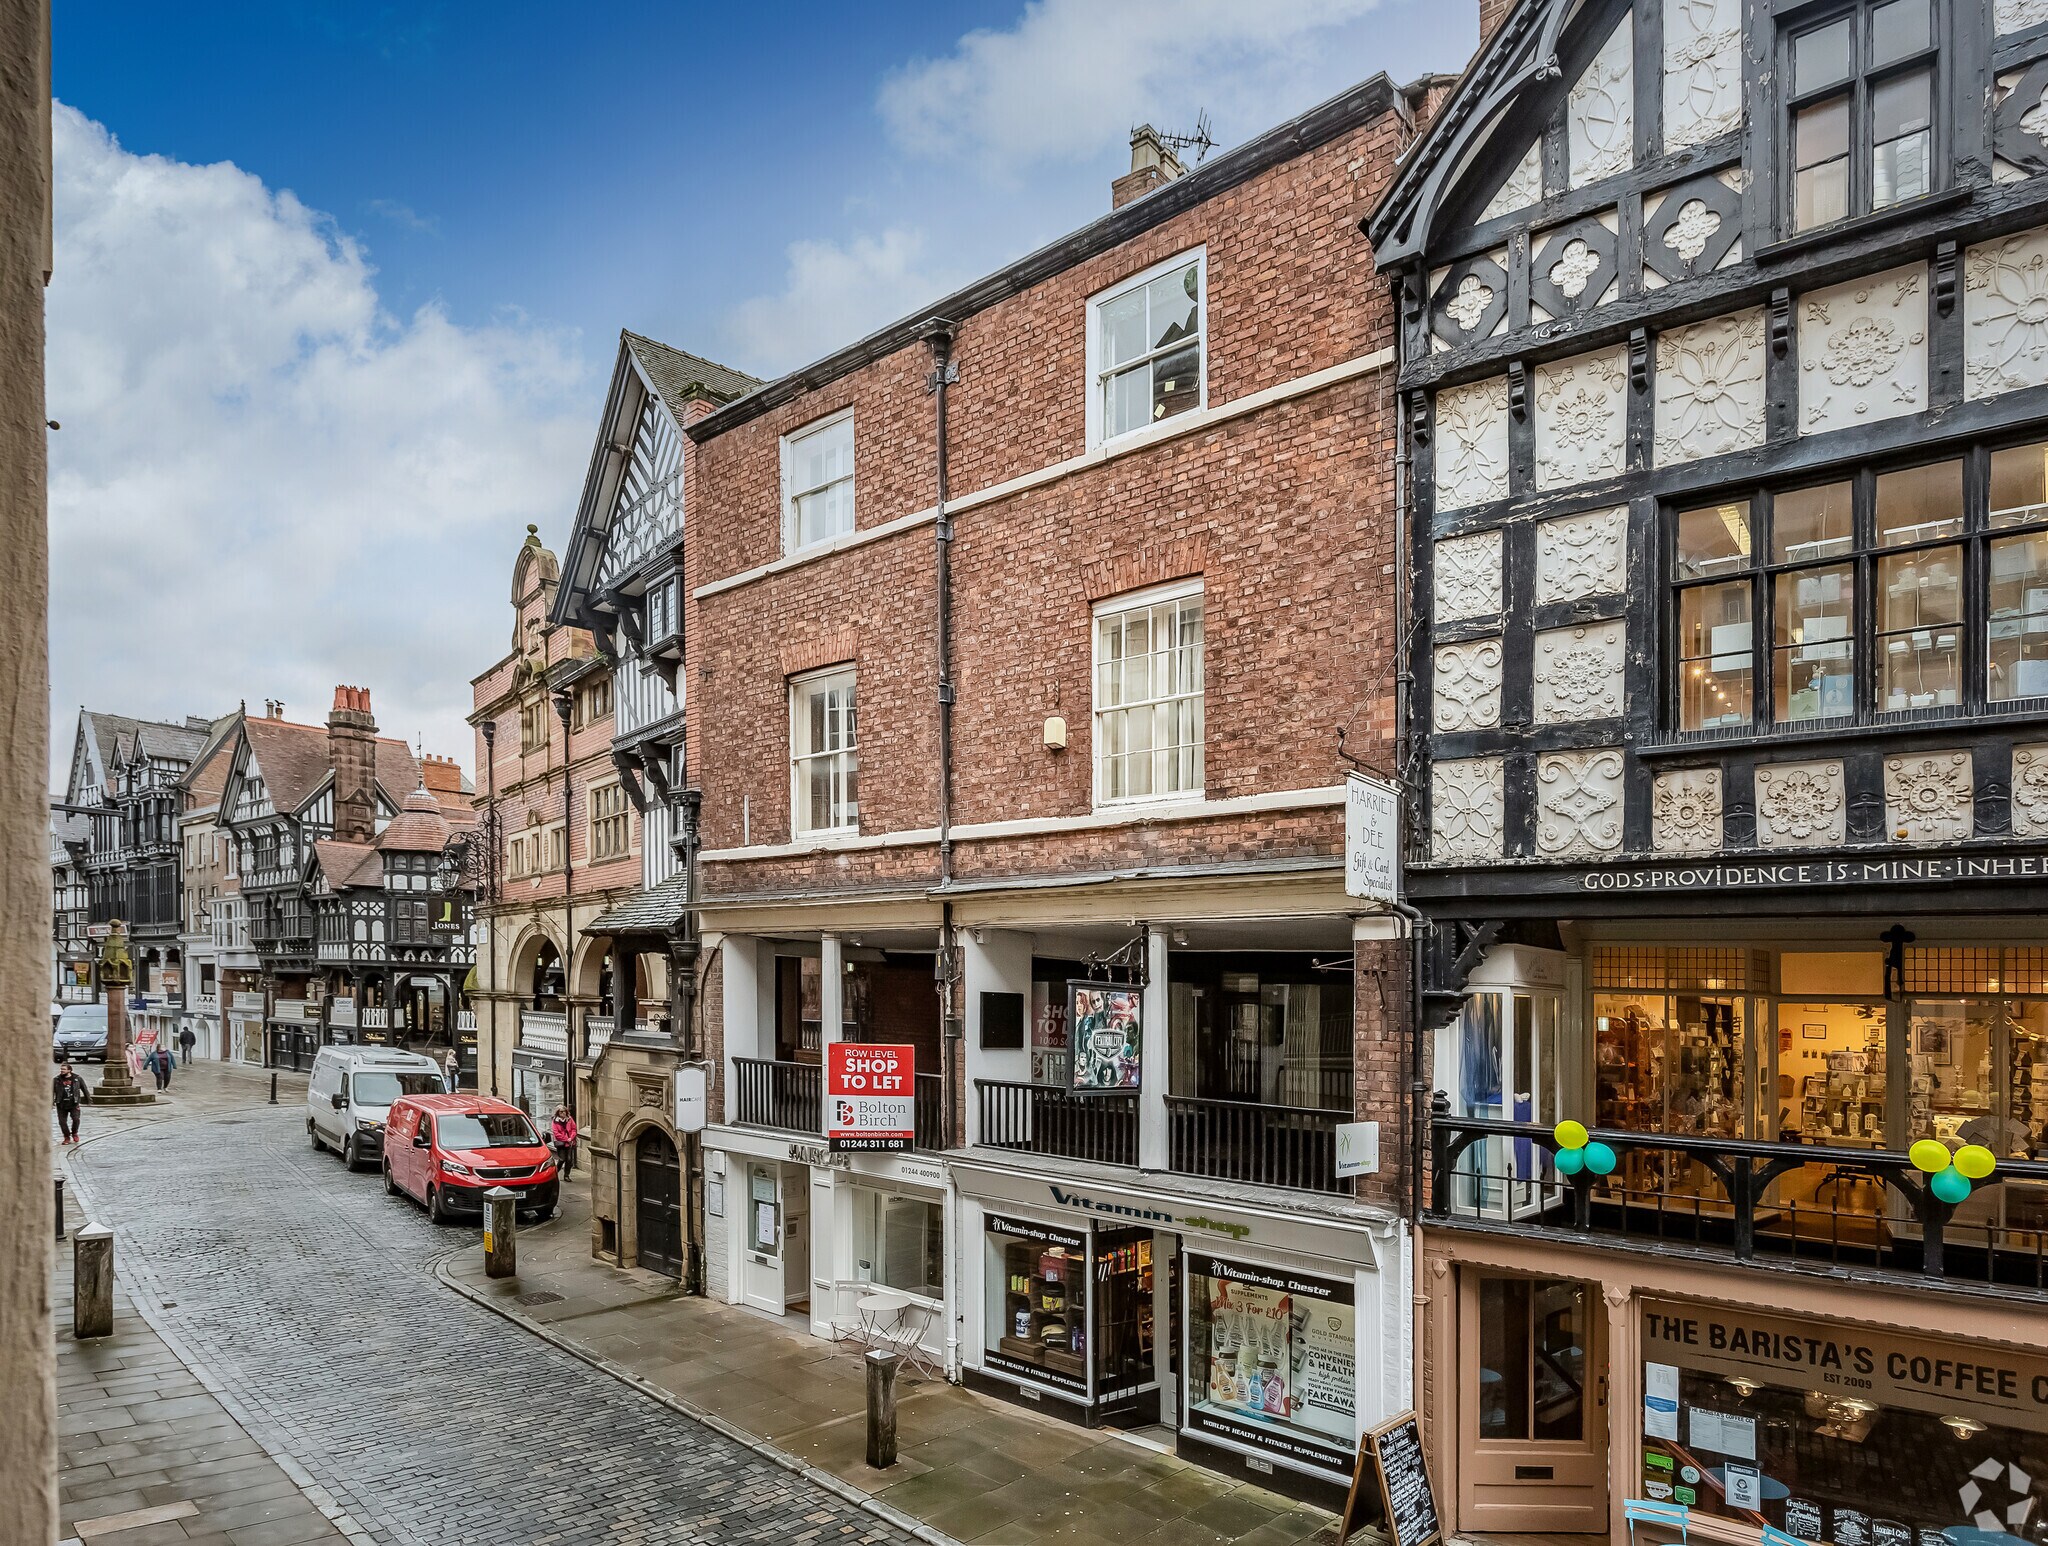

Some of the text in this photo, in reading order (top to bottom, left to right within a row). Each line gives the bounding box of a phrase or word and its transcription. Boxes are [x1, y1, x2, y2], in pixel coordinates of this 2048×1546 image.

[1351, 785, 1394, 816] HARRIET
[1370, 813, 1377, 827] &
[1362, 827, 1385, 849] DEE
[1353, 851, 1366, 873] Gift
[1374, 857, 1390, 874] Card
[1363, 871, 1393, 892] Specialist
[1584, 872, 1644, 889] GODS
[1651, 865, 1811, 887] PROVIDENCE
[1826, 861, 1849, 882] IS
[1863, 860, 1942, 880] MINE
[431, 921, 461, 931] JONES
[1037, 1019, 1057, 1034] TO
[1040, 1036, 1058, 1046] 1000
[845, 1049, 898, 1059] ROW LEVEL
[845, 1058, 899, 1073] SHOP
[841, 1074, 903, 1090] TO LET
[859, 1101, 907, 1114] Bolton
[859, 1114, 897, 1127] Birch
[840, 1140, 904, 1148] 01244 311 681
[901, 1166, 941, 1179] 01244 400900
[1048, 1232, 1081, 1246] Chester
[1230, 1288, 1269, 1301] SUPPLEMENTS
[1288, 1280, 1332, 1297] Chester
[1235, 1300, 1243, 1313] 3
[1245, 1302, 1264, 1315] For
[1265, 1306, 1284, 1320] £10
[1311, 1328, 1328, 1337] GOLD
[1308, 1358, 1315, 1368] &
[1645, 1313, 1699, 1345] THE
[1708, 1323, 1875, 1374] BARISTA'S
[1886, 1352, 2018, 1399] COFFEE
[1006, 1361, 1025, 1371] HEALTH
[1030, 1368, 1051, 1379] FITNESS
[1051, 1375, 1087, 1391] SUPPLEMENTS
[1823, 1372, 1872, 1389] EST 2009
[1203, 1419, 1343, 1465] WORLD'S HEALTH & FITNESS SUPPLEMENTS
